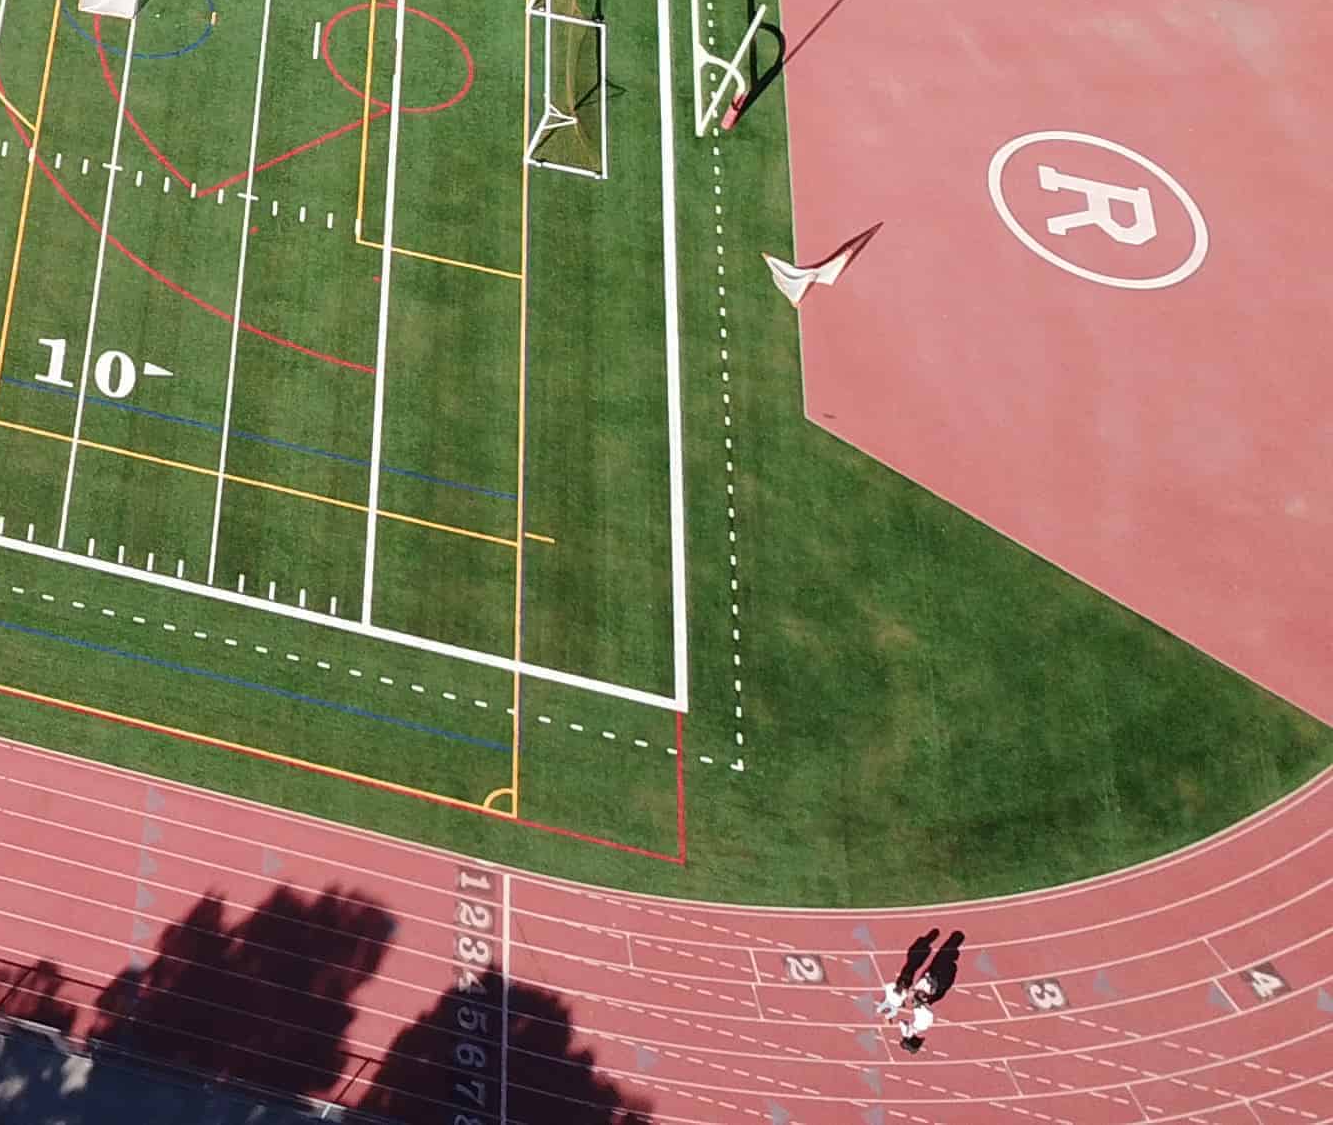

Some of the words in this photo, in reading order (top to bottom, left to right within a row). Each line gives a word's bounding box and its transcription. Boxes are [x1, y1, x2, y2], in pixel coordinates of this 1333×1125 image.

[1039, 165, 1157, 244] R
[34, 337, 136, 399] 10
[459, 871, 491, 889] 1
[458, 902, 490, 928] 2
[458, 936, 489, 964] 3
[790, 956, 819, 982] 2
[458, 971, 486, 994] 4
[1252, 971, 1282, 998] 4
[1029, 984, 1065, 1010] 3
[456, 1006, 488, 1034] 5
[456, 1042, 486, 1068] 6
[455, 1079, 486, 1108] 7
